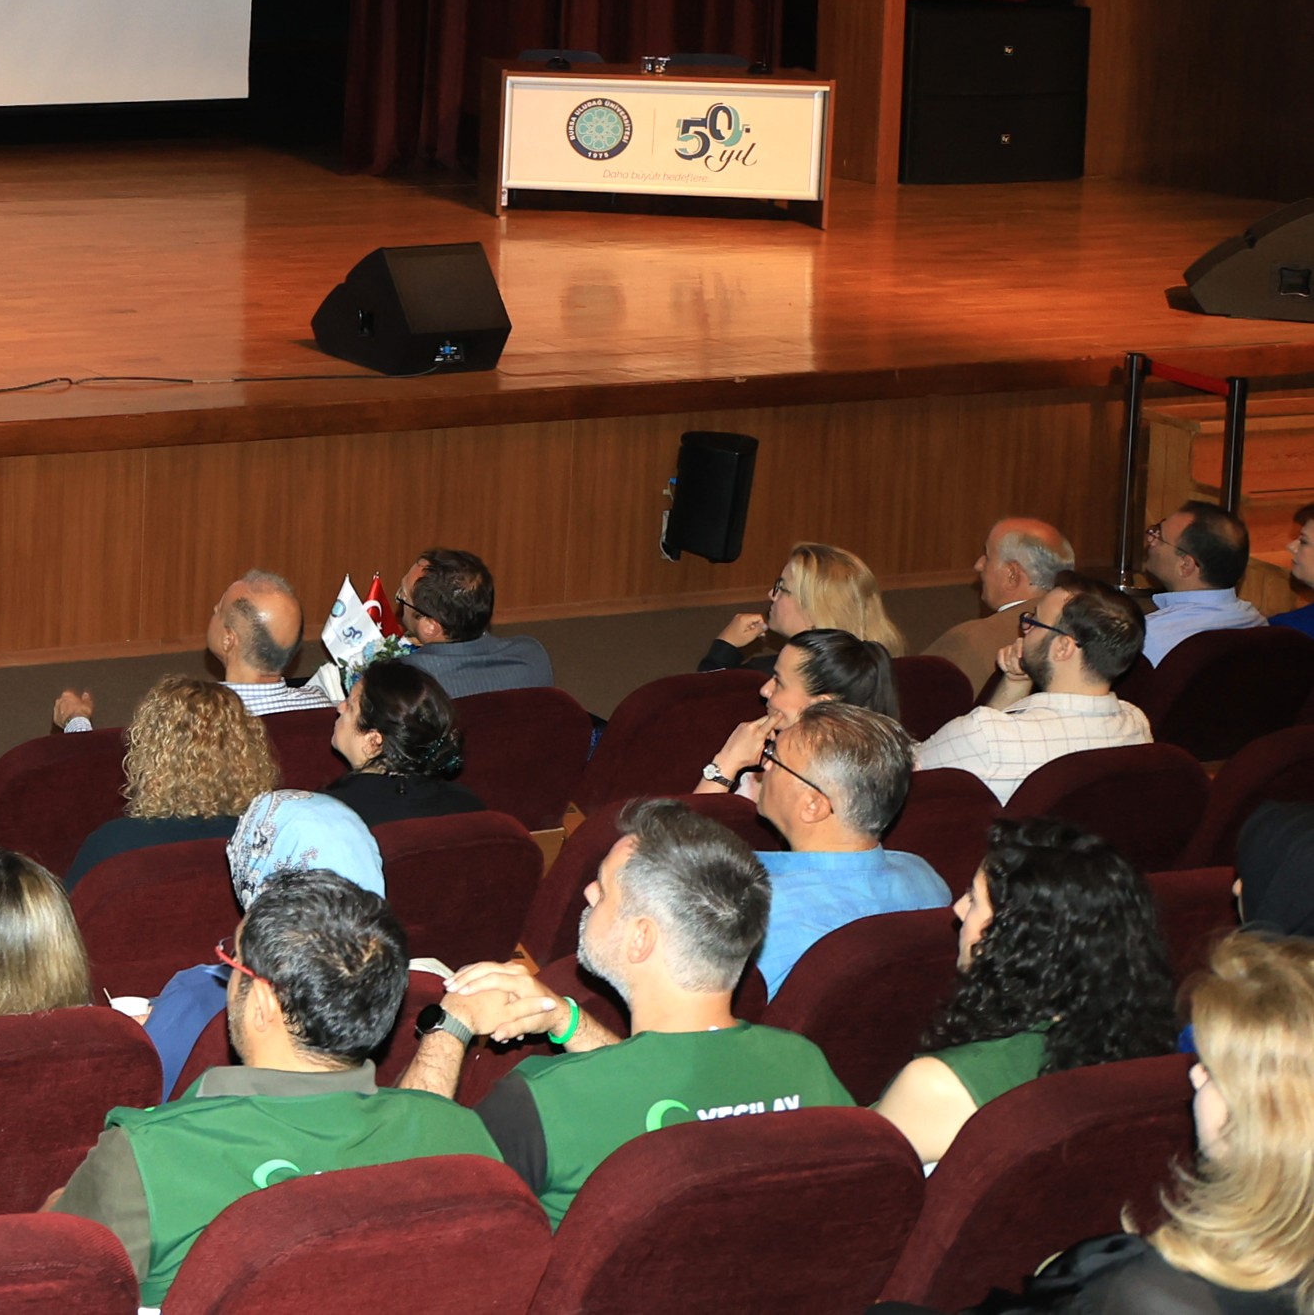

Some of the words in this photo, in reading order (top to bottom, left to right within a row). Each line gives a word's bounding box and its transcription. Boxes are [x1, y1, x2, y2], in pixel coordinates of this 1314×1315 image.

[568, 117, 578, 141] BURSA
[574, 99, 603, 116] ULUDAĞ
[587, 151, 610, 159] 1975
